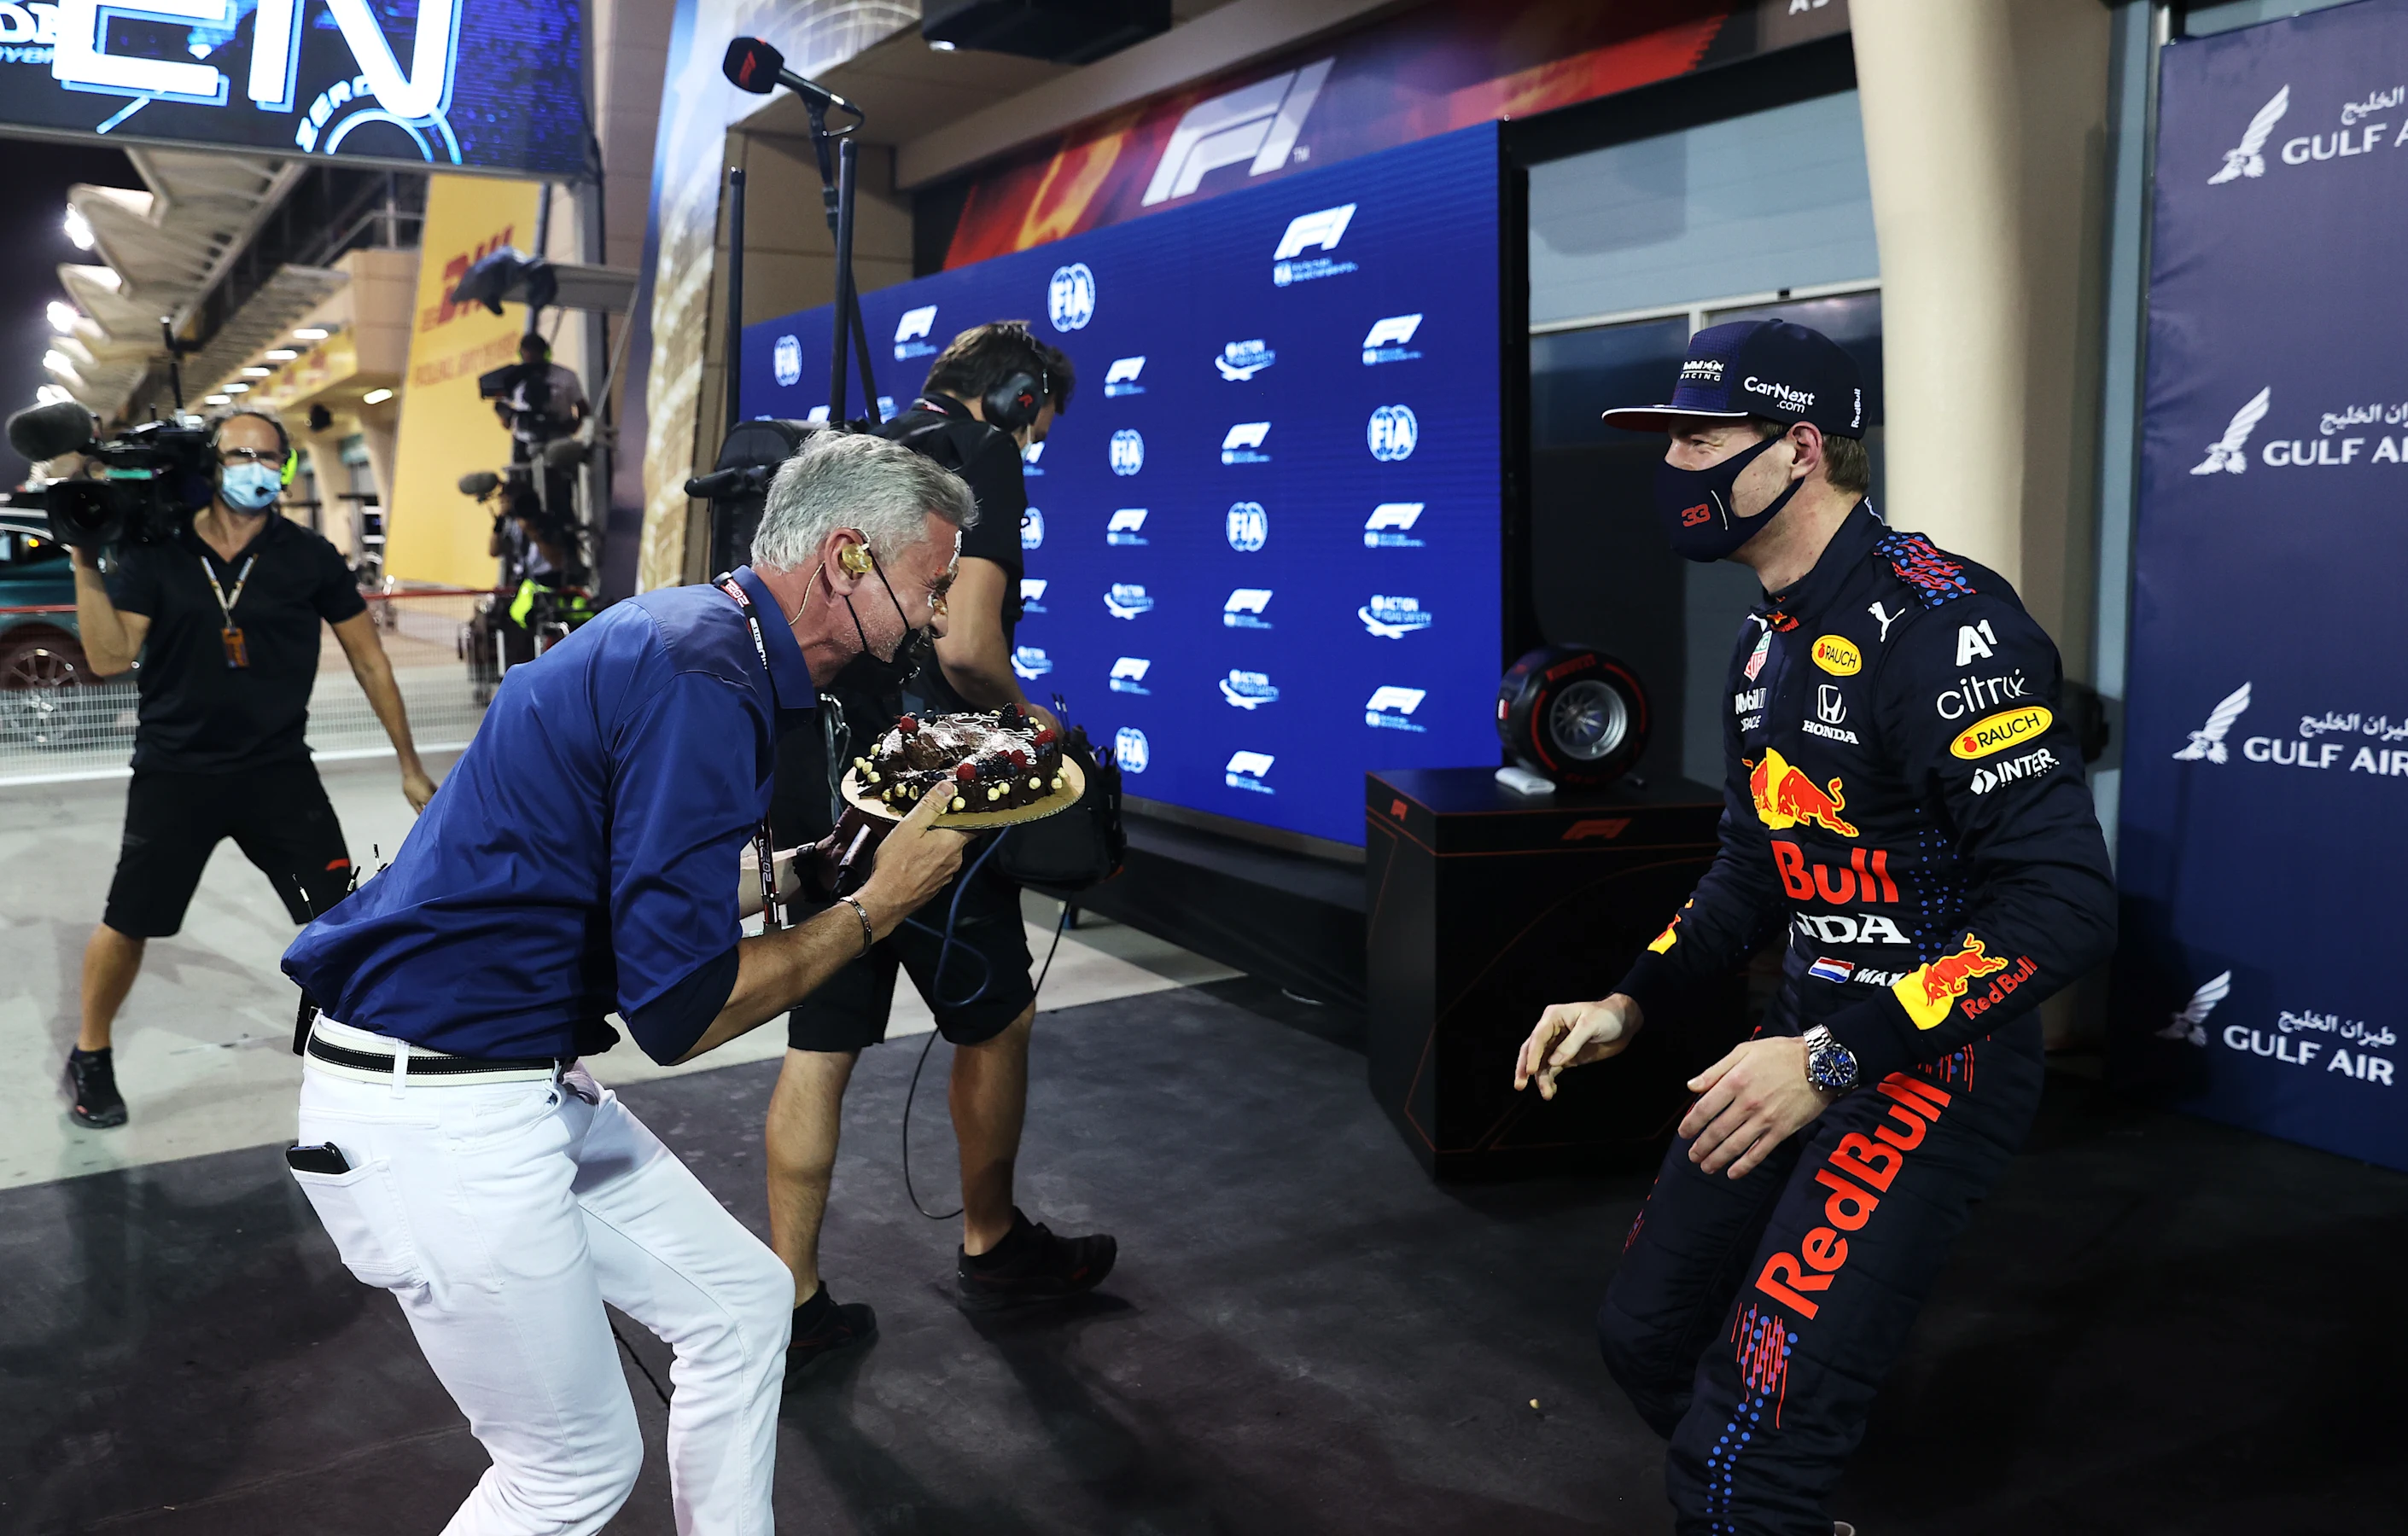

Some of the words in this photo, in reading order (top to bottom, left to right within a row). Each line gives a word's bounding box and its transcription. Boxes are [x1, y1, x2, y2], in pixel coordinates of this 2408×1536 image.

[2282, 123, 2388, 166] GULF
[1049, 274, 1093, 323] FIA
[1680, 373, 1721, 381] RACING
[1744, 376, 1816, 406] CarNext
[1776, 400, 1805, 414] .com
[1369, 414, 1413, 452] FIA
[2263, 439, 2366, 467] GULF
[1227, 509, 1265, 544] FIA
[1682, 503, 1711, 527] 33
[1825, 645, 1858, 669] RAUCH
[1956, 619, 1998, 666] A1
[1937, 668, 2033, 719] citrix
[1802, 719, 1859, 745] HONDA
[1976, 713, 2041, 748] RAUCH
[1116, 732, 1146, 767] FIA
[1996, 748, 2056, 783] INTER
[2243, 736, 2345, 769] GULF
[1770, 840, 1899, 905] Bull
[2223, 1025, 2322, 1066] GULF
[2327, 1048, 2394, 1086] AIR
